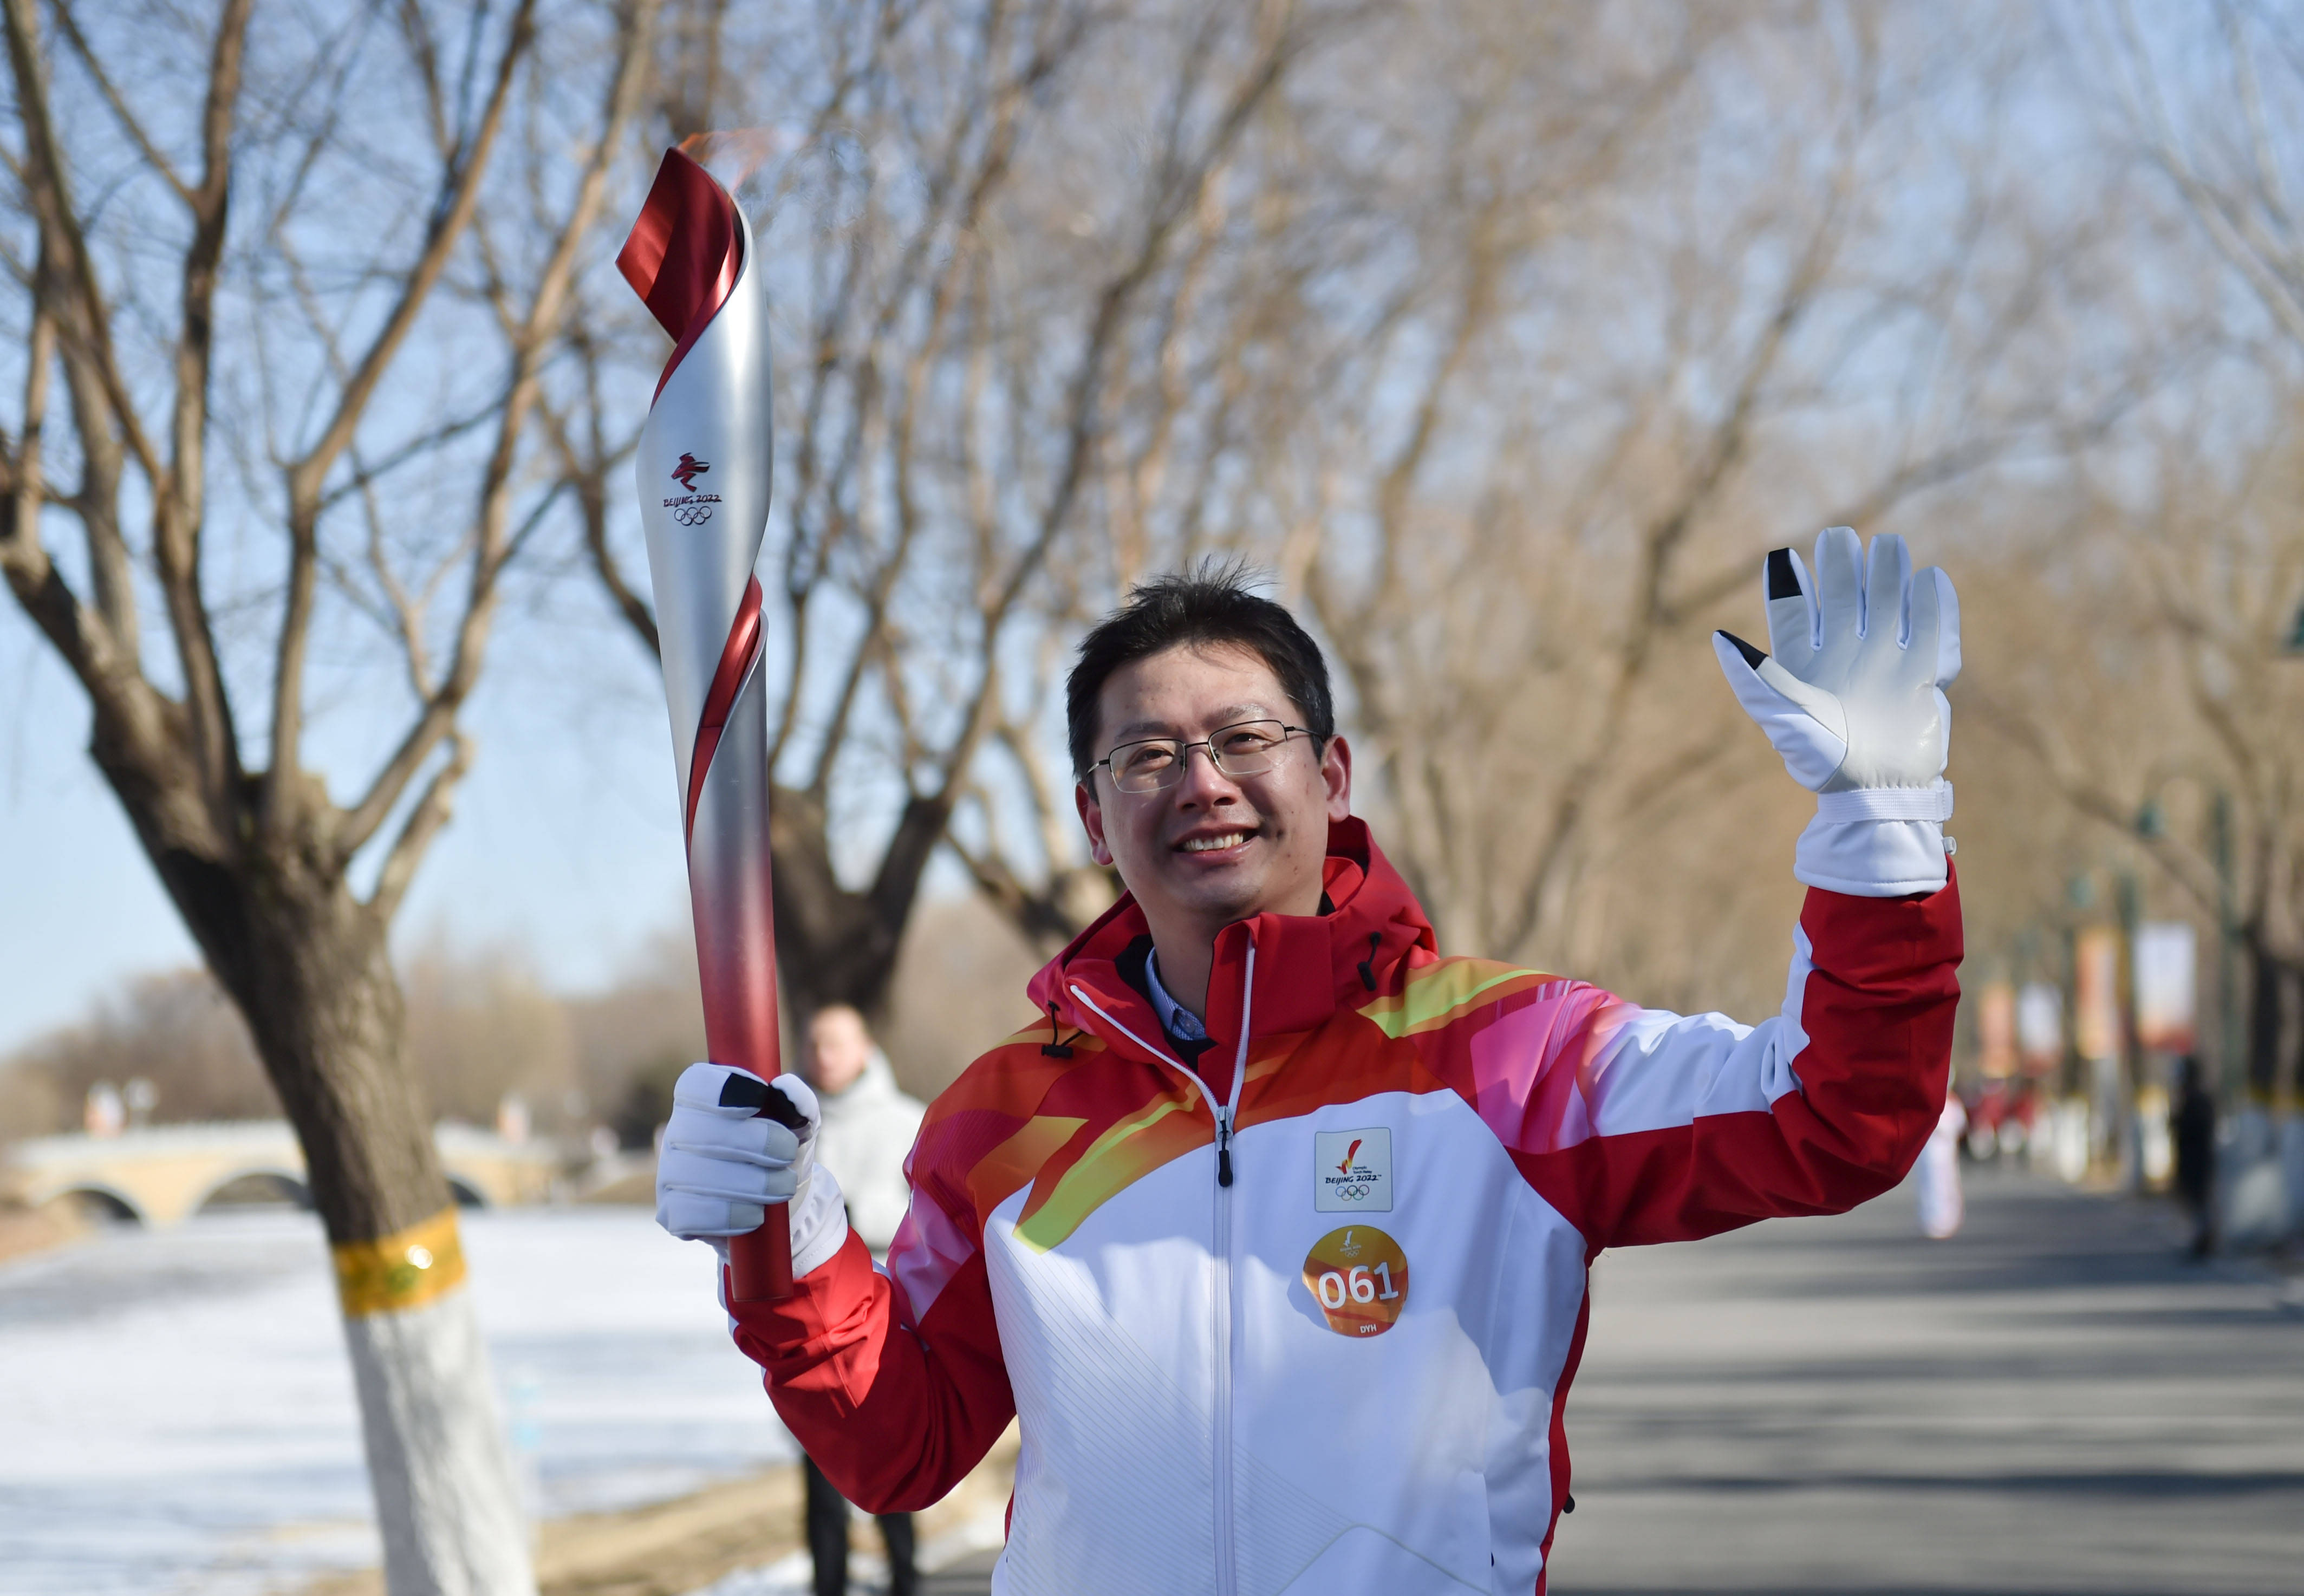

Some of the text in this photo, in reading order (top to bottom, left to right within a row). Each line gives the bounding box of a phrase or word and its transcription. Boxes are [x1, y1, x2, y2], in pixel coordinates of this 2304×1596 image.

[663, 494, 723, 507] BEIJING 2022
[1325, 1176, 1354, 1185] BEIJING
[1318, 1262, 1399, 1310] 061
[1360, 1324, 1377, 1334] DYH
